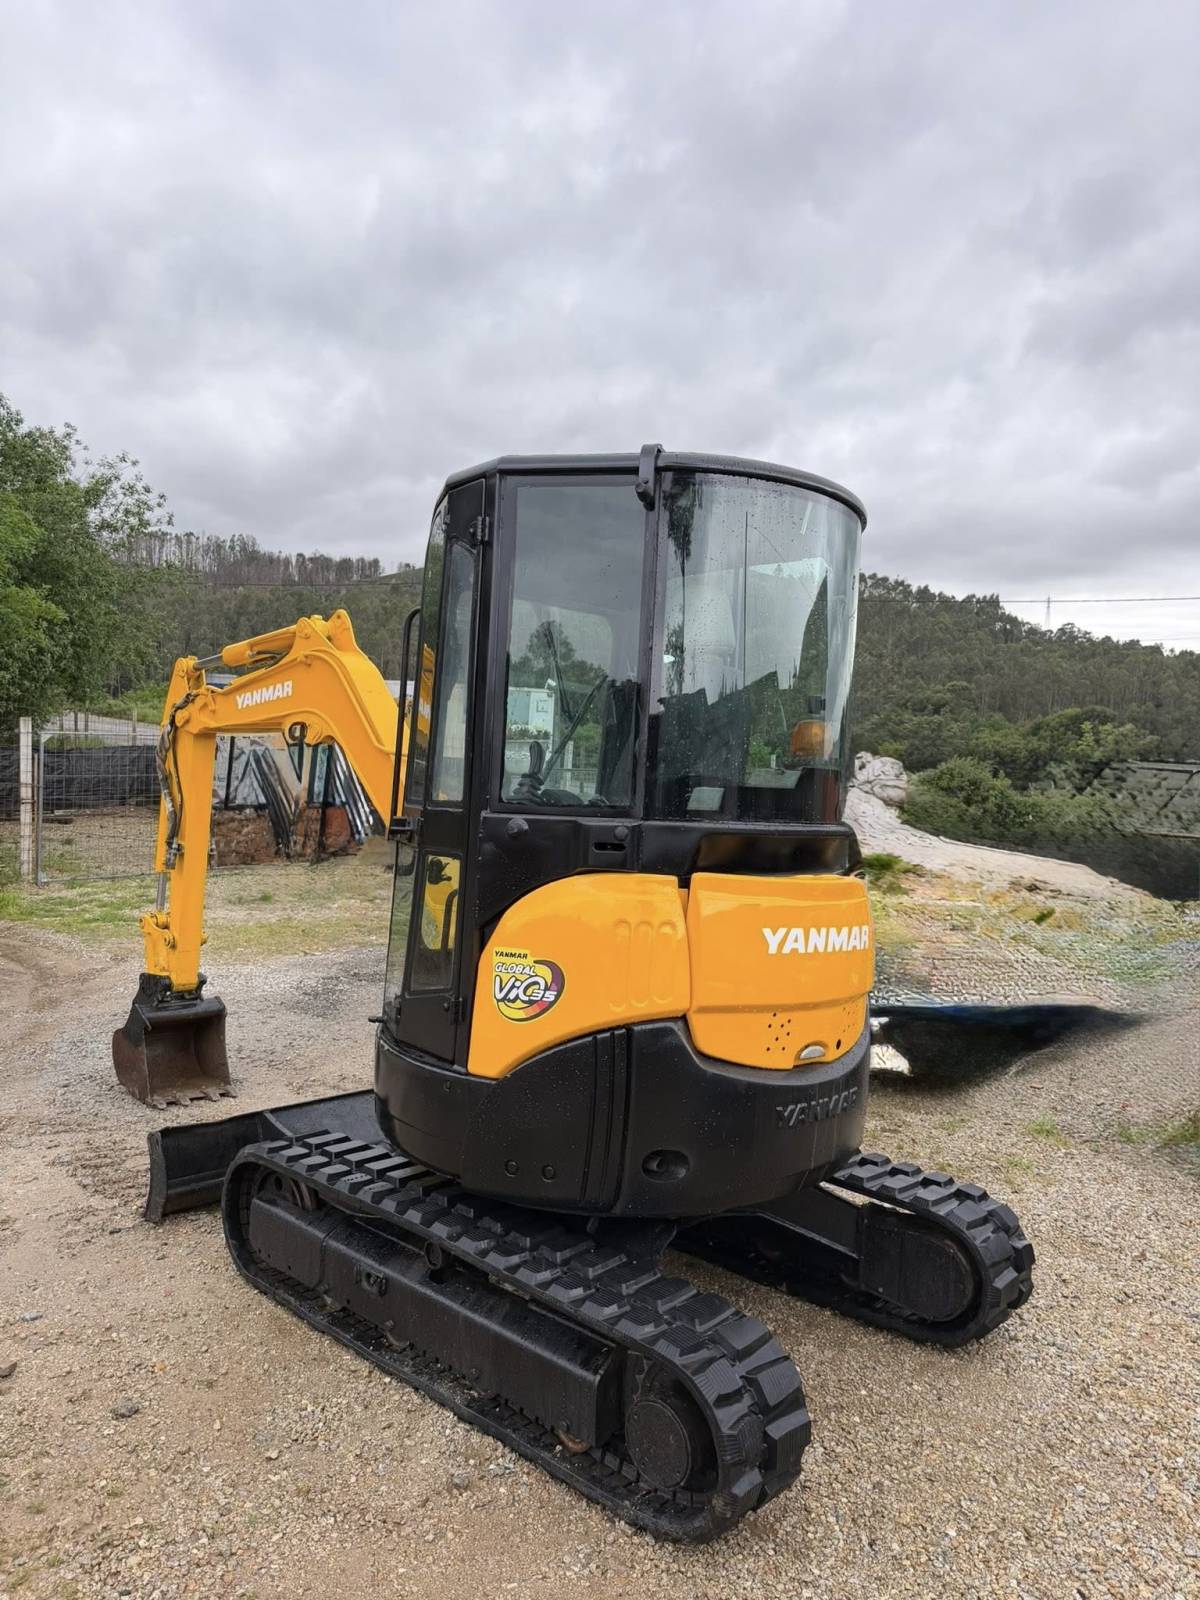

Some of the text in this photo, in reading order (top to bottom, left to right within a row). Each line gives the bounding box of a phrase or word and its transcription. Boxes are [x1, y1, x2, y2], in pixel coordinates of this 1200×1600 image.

[236, 680, 293, 710] YANMAR
[762, 925, 869, 954] YANMAR
[495, 950, 528, 960] YANMAR
[495, 962, 537, 976] GLOBAL
